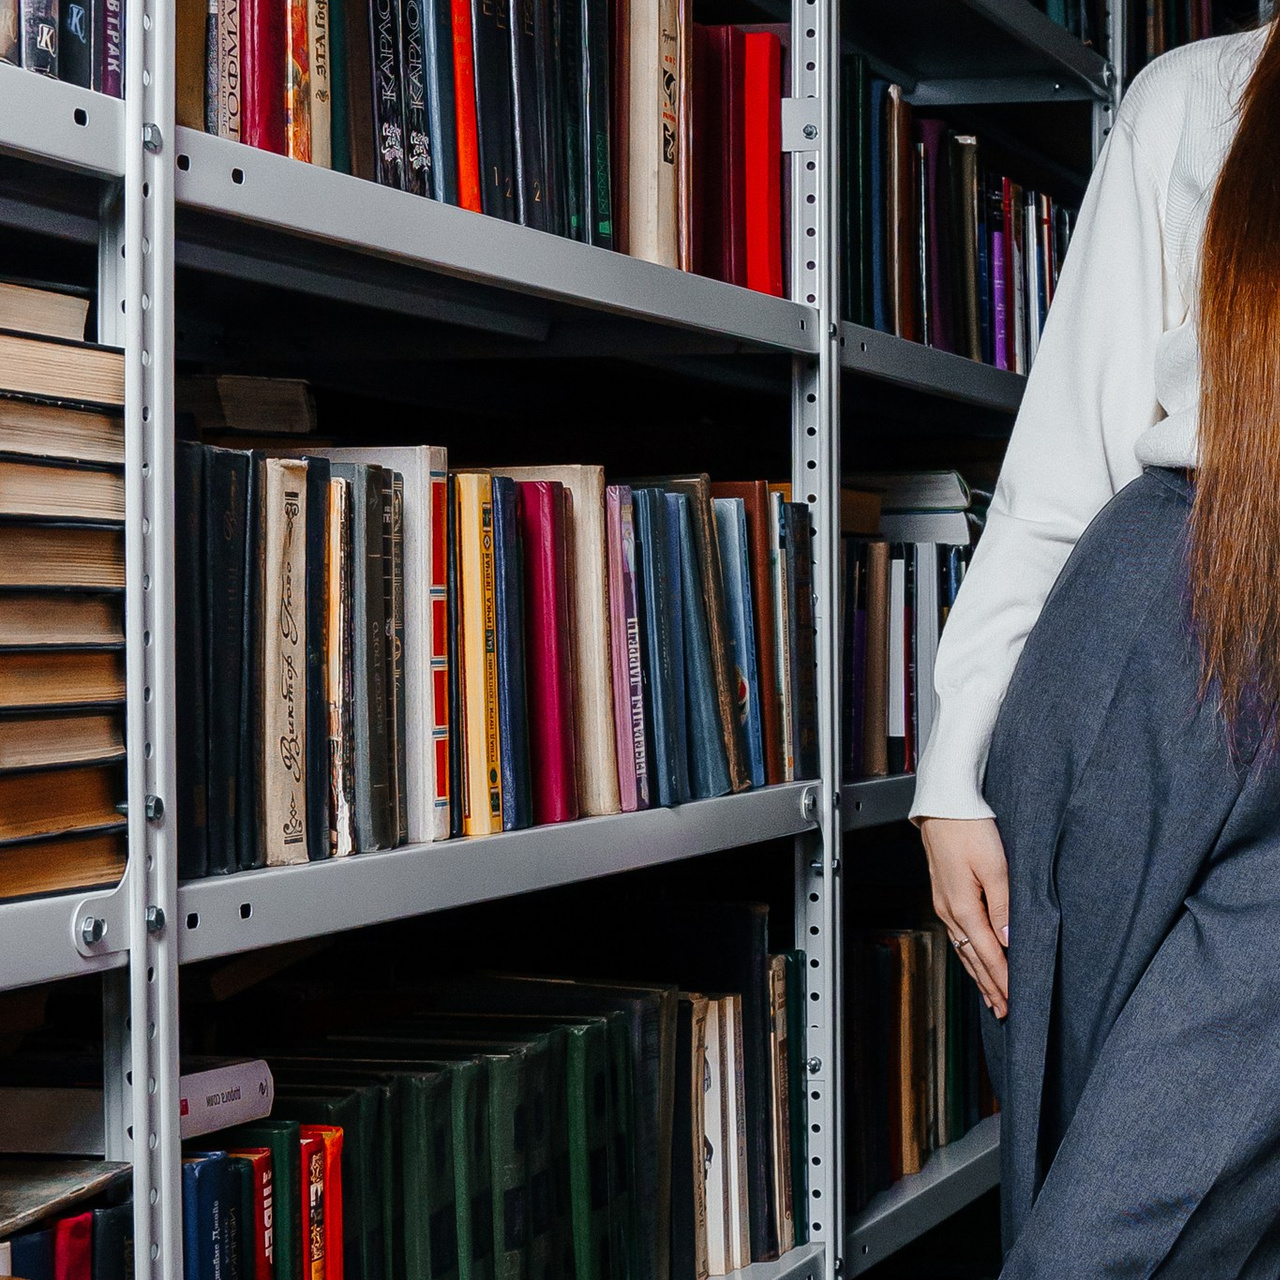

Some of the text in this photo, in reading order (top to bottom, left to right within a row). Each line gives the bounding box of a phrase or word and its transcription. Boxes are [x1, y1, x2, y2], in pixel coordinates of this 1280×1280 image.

[406, 0, 425, 111] КАРЛО
[279, 561, 302, 783] Виктор Гюго
[626, 617, 642, 687] ДАРРЕЛЛ
[221, 1086, 242, 1105] дорога
[211, 1200, 221, 1241] Джойс
